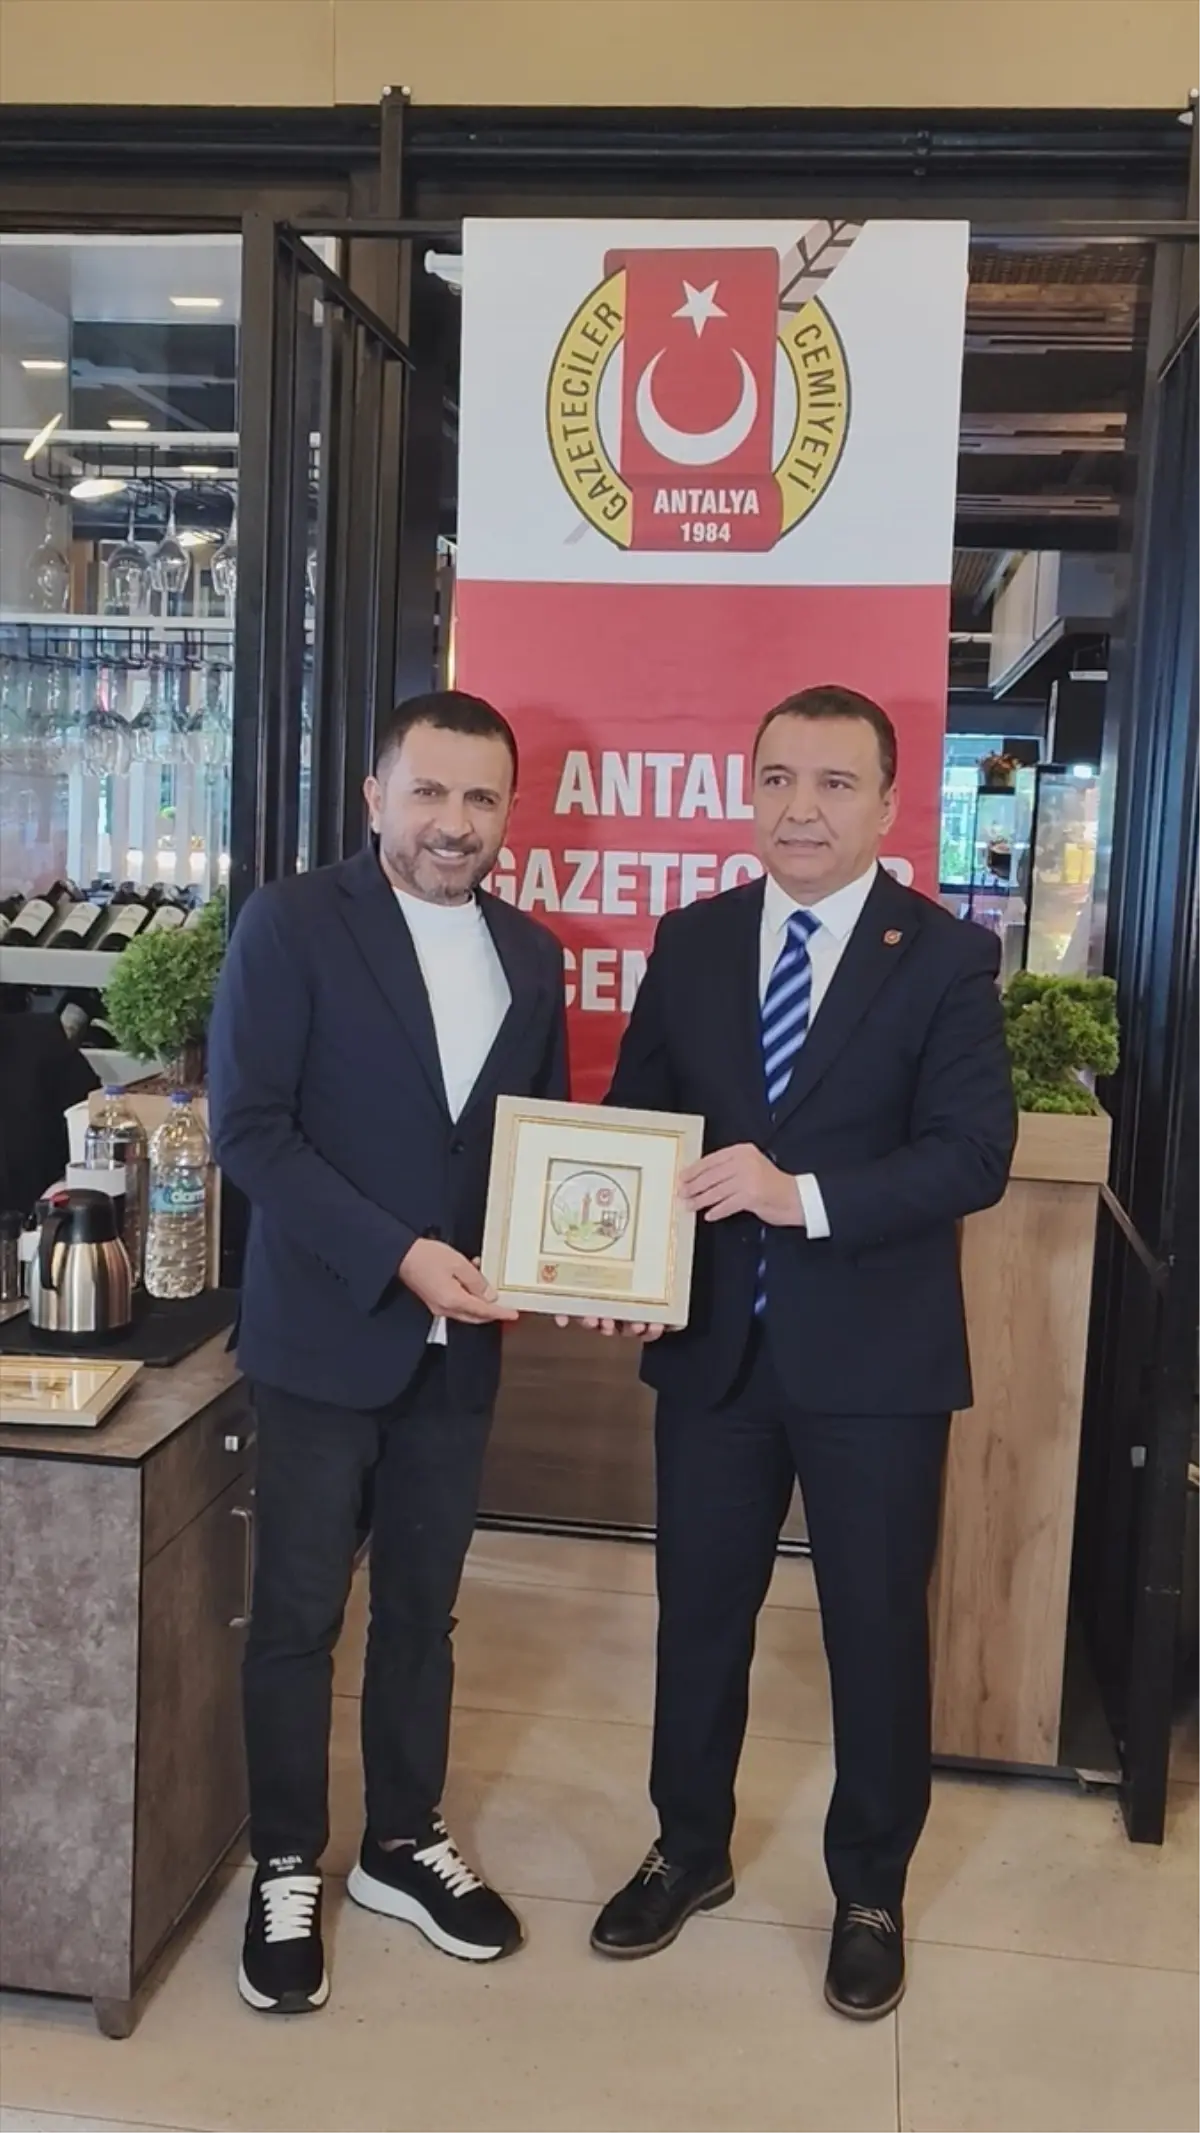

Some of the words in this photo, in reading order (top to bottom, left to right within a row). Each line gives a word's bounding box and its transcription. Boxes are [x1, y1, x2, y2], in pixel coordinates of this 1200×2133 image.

[561, 301, 628, 521] GAZETECİLER
[788, 323, 842, 494] CEMİYETİ
[653, 488, 760, 515] ANTALYA
[680, 521, 732, 543] 1984
[554, 750, 755, 821] ANTAL
